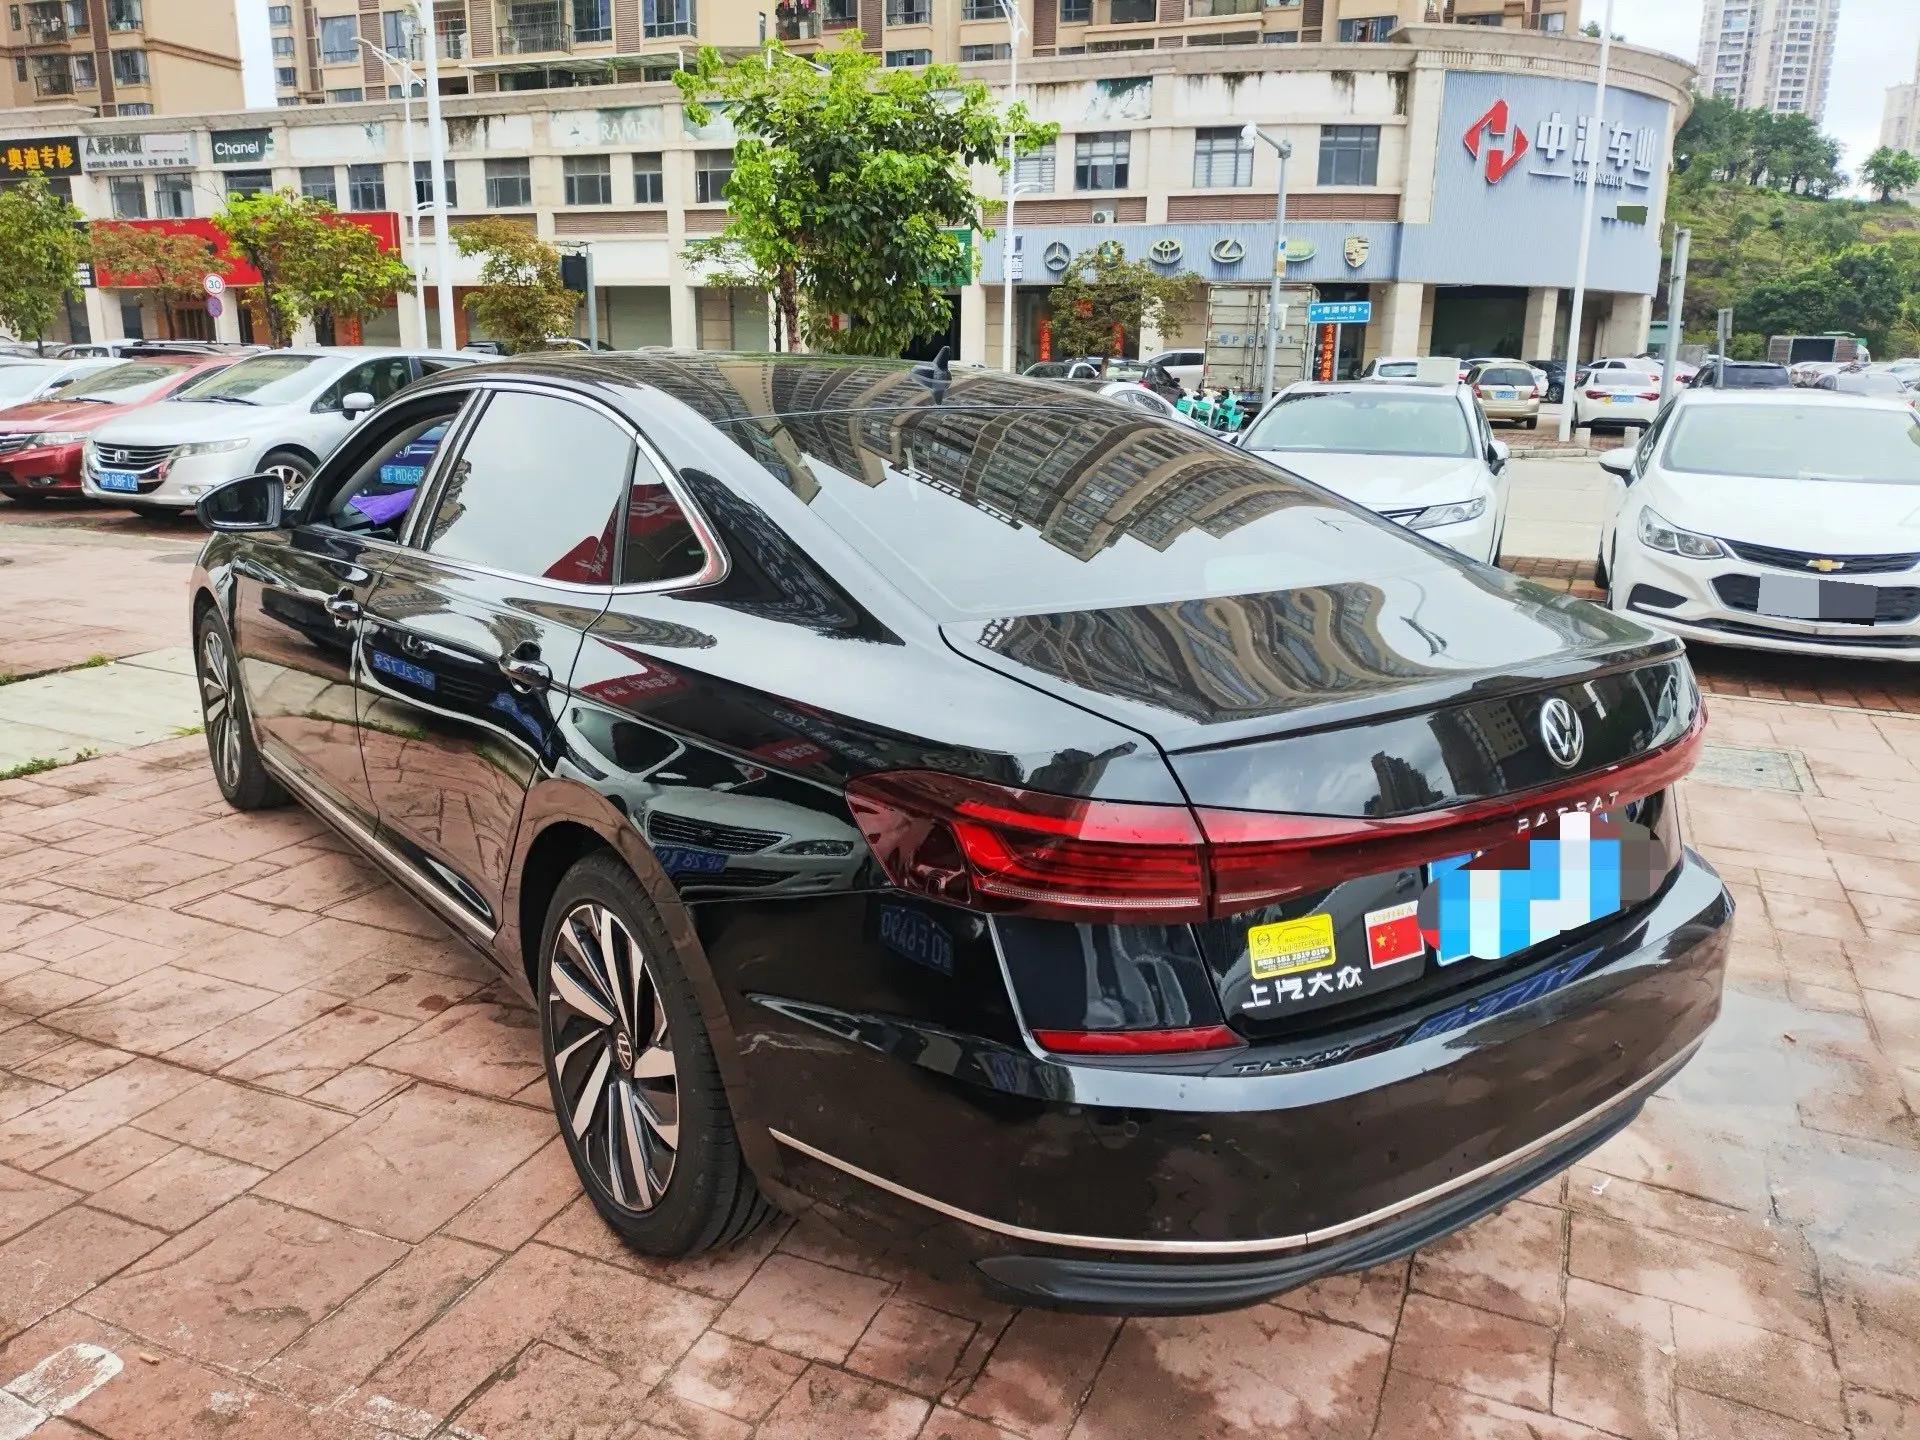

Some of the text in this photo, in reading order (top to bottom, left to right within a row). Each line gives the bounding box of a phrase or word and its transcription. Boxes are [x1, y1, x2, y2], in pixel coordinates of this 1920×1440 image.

[215, 141, 260, 155] Chanel
[208, 280, 221, 289] 30
[1242, 965, 1363, 1009] 上汽大众
